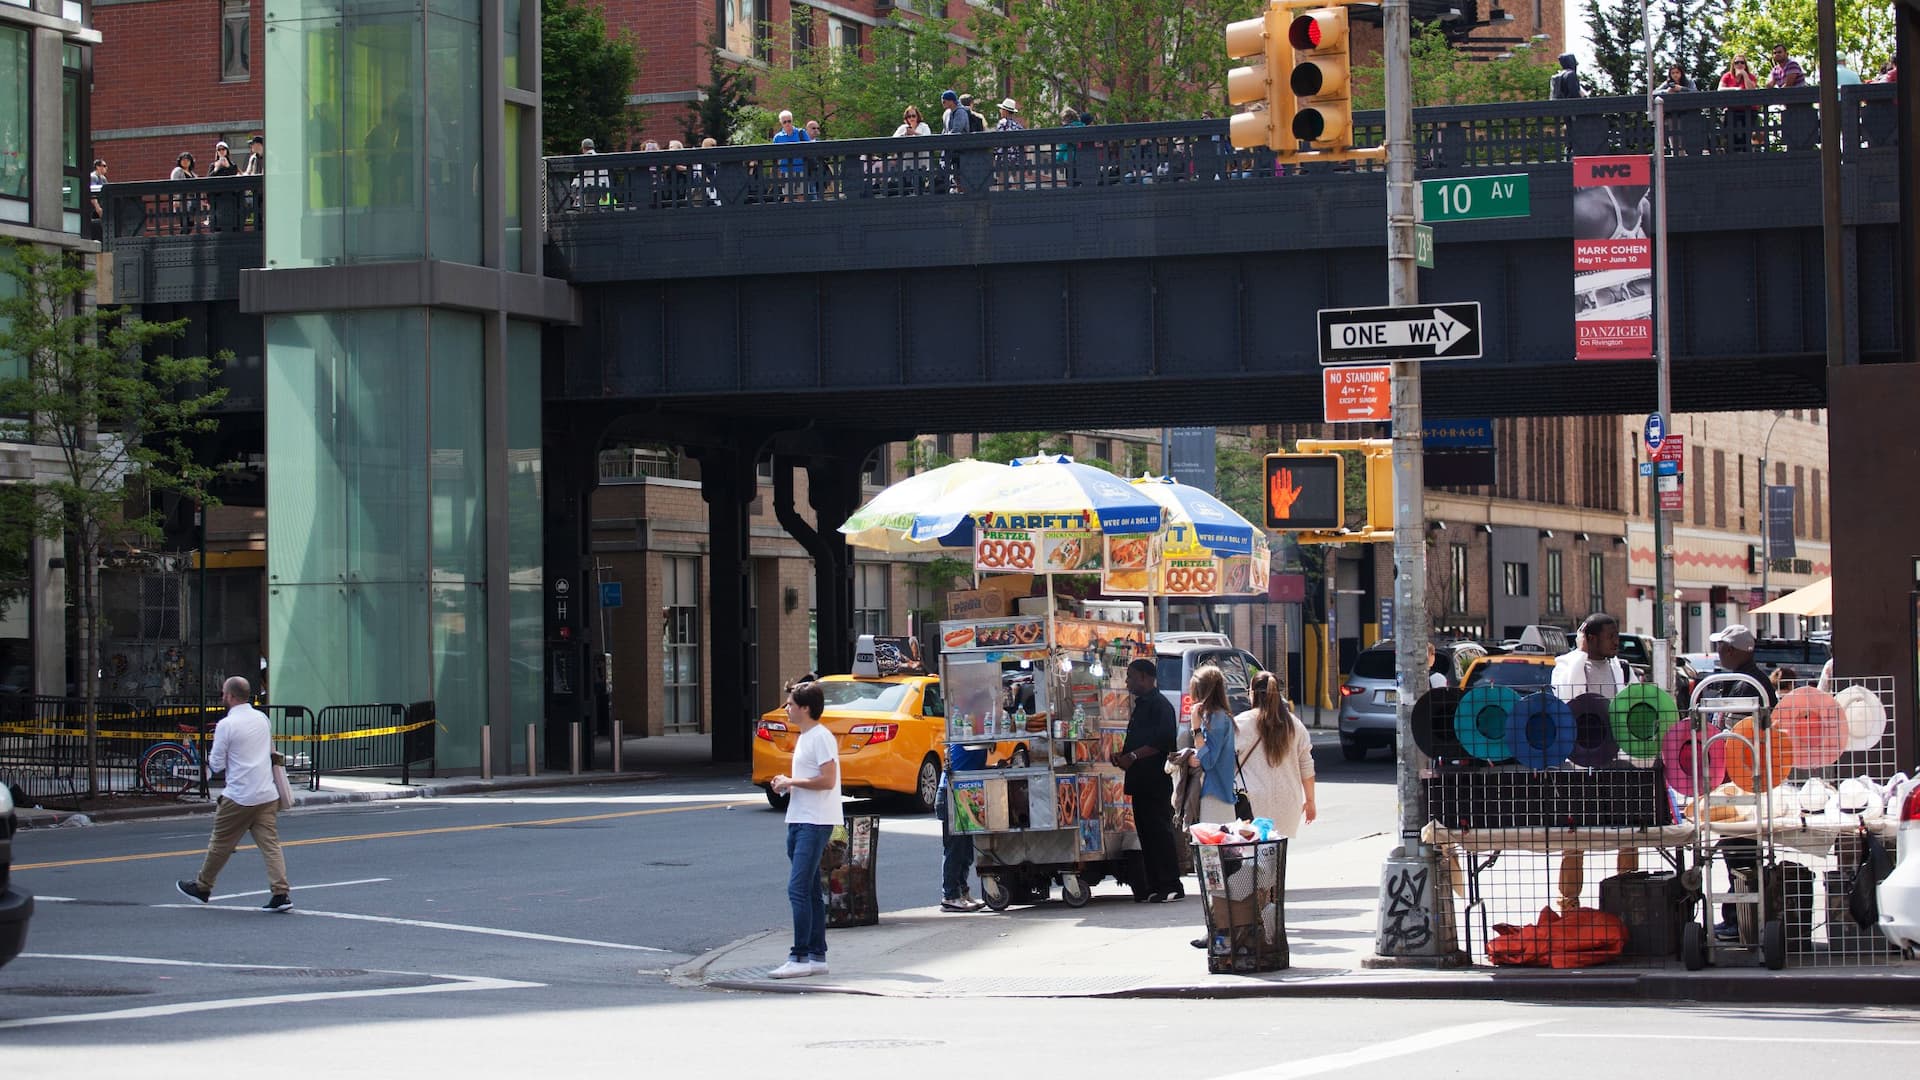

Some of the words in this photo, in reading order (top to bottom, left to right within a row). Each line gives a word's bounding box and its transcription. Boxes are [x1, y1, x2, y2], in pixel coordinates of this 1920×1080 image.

[1592, 164, 1631, 178] NYC
[1438, 184, 1472, 214] 10
[1491, 181, 1514, 199] Av
[1417, 232, 1427, 261] 23
[1578, 246, 1608, 255] MARK
[1611, 245, 1647, 254] COHEN
[1343, 324, 1388, 346] ONE
[1409, 321, 1454, 343] WAY
[1580, 325, 1647, 337] DANZIGER
[1592, 339, 1623, 347] Rivington
[1330, 373, 1342, 385] NO
[1346, 371, 1385, 383] STANDING
[1423, 428, 1484, 438] STORAGE
[1119, 518, 1129, 526] ON
[1135, 517, 1149, 525] ROLL
[983, 531, 1031, 541] PRETZEL
[1171, 560, 1214, 568] PRETZEL
